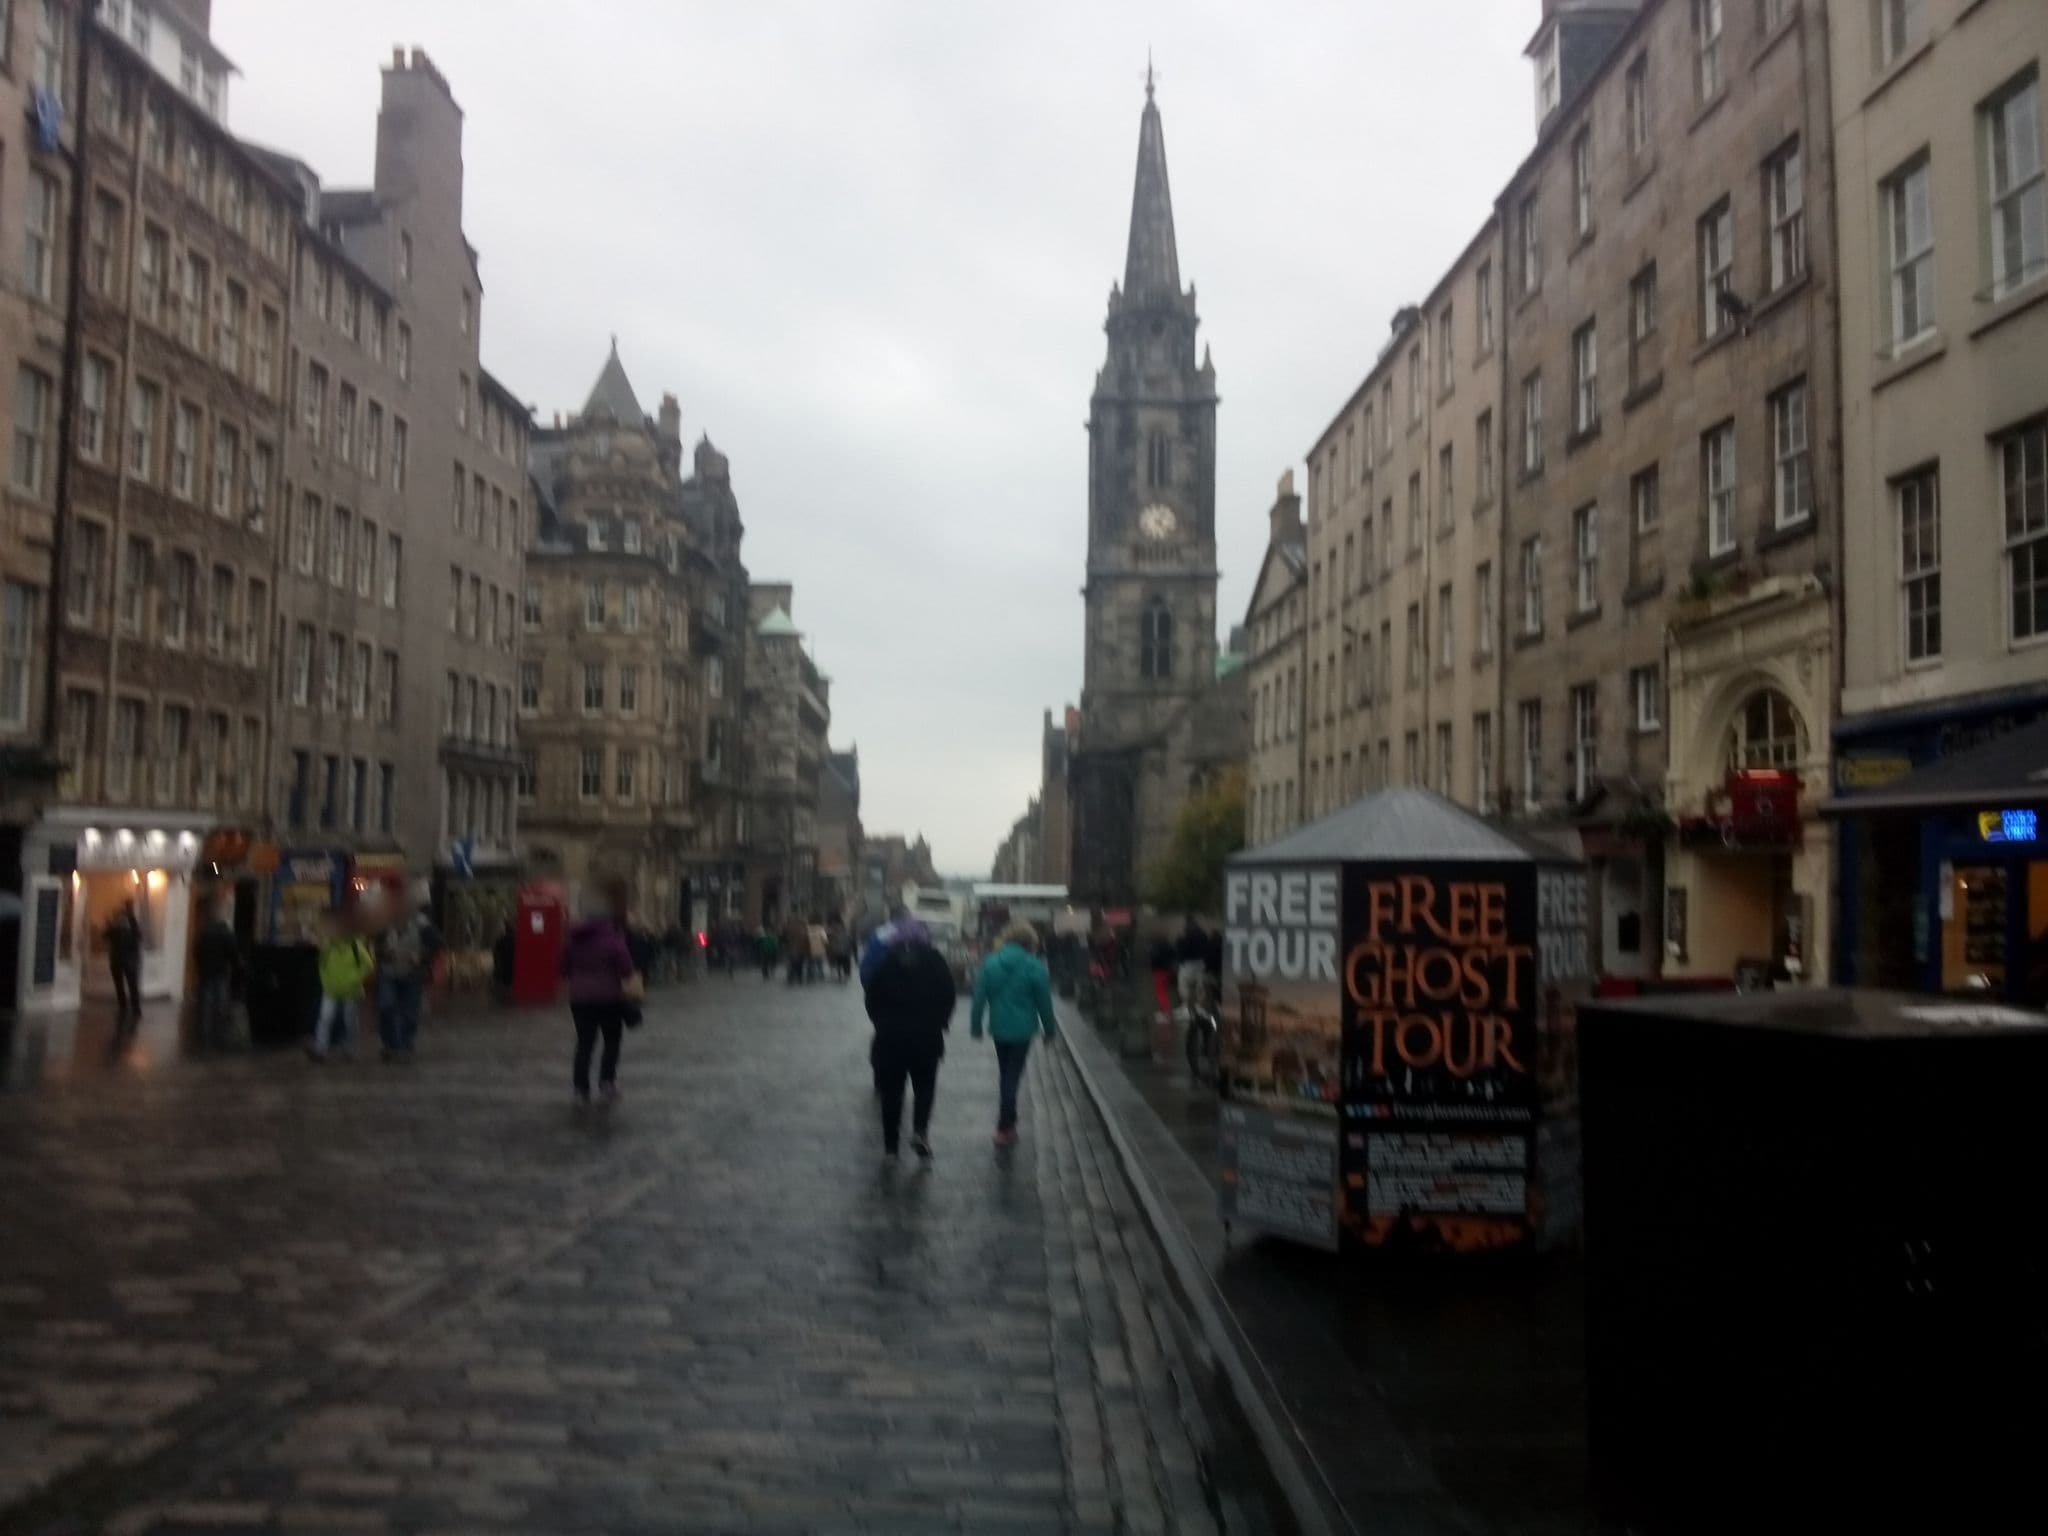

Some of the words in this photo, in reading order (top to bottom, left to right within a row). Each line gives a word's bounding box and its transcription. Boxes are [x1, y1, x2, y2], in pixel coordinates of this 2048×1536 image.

[1226, 871, 1338, 926] FREE
[1368, 874, 1508, 948] FREE
[1538, 871, 1587, 926] FREE
[1226, 928, 1338, 982] TOUR
[1347, 944, 1532, 1010] GHOST
[1538, 931, 1587, 982] TOUR
[1357, 1007, 1526, 1076] TOUR
